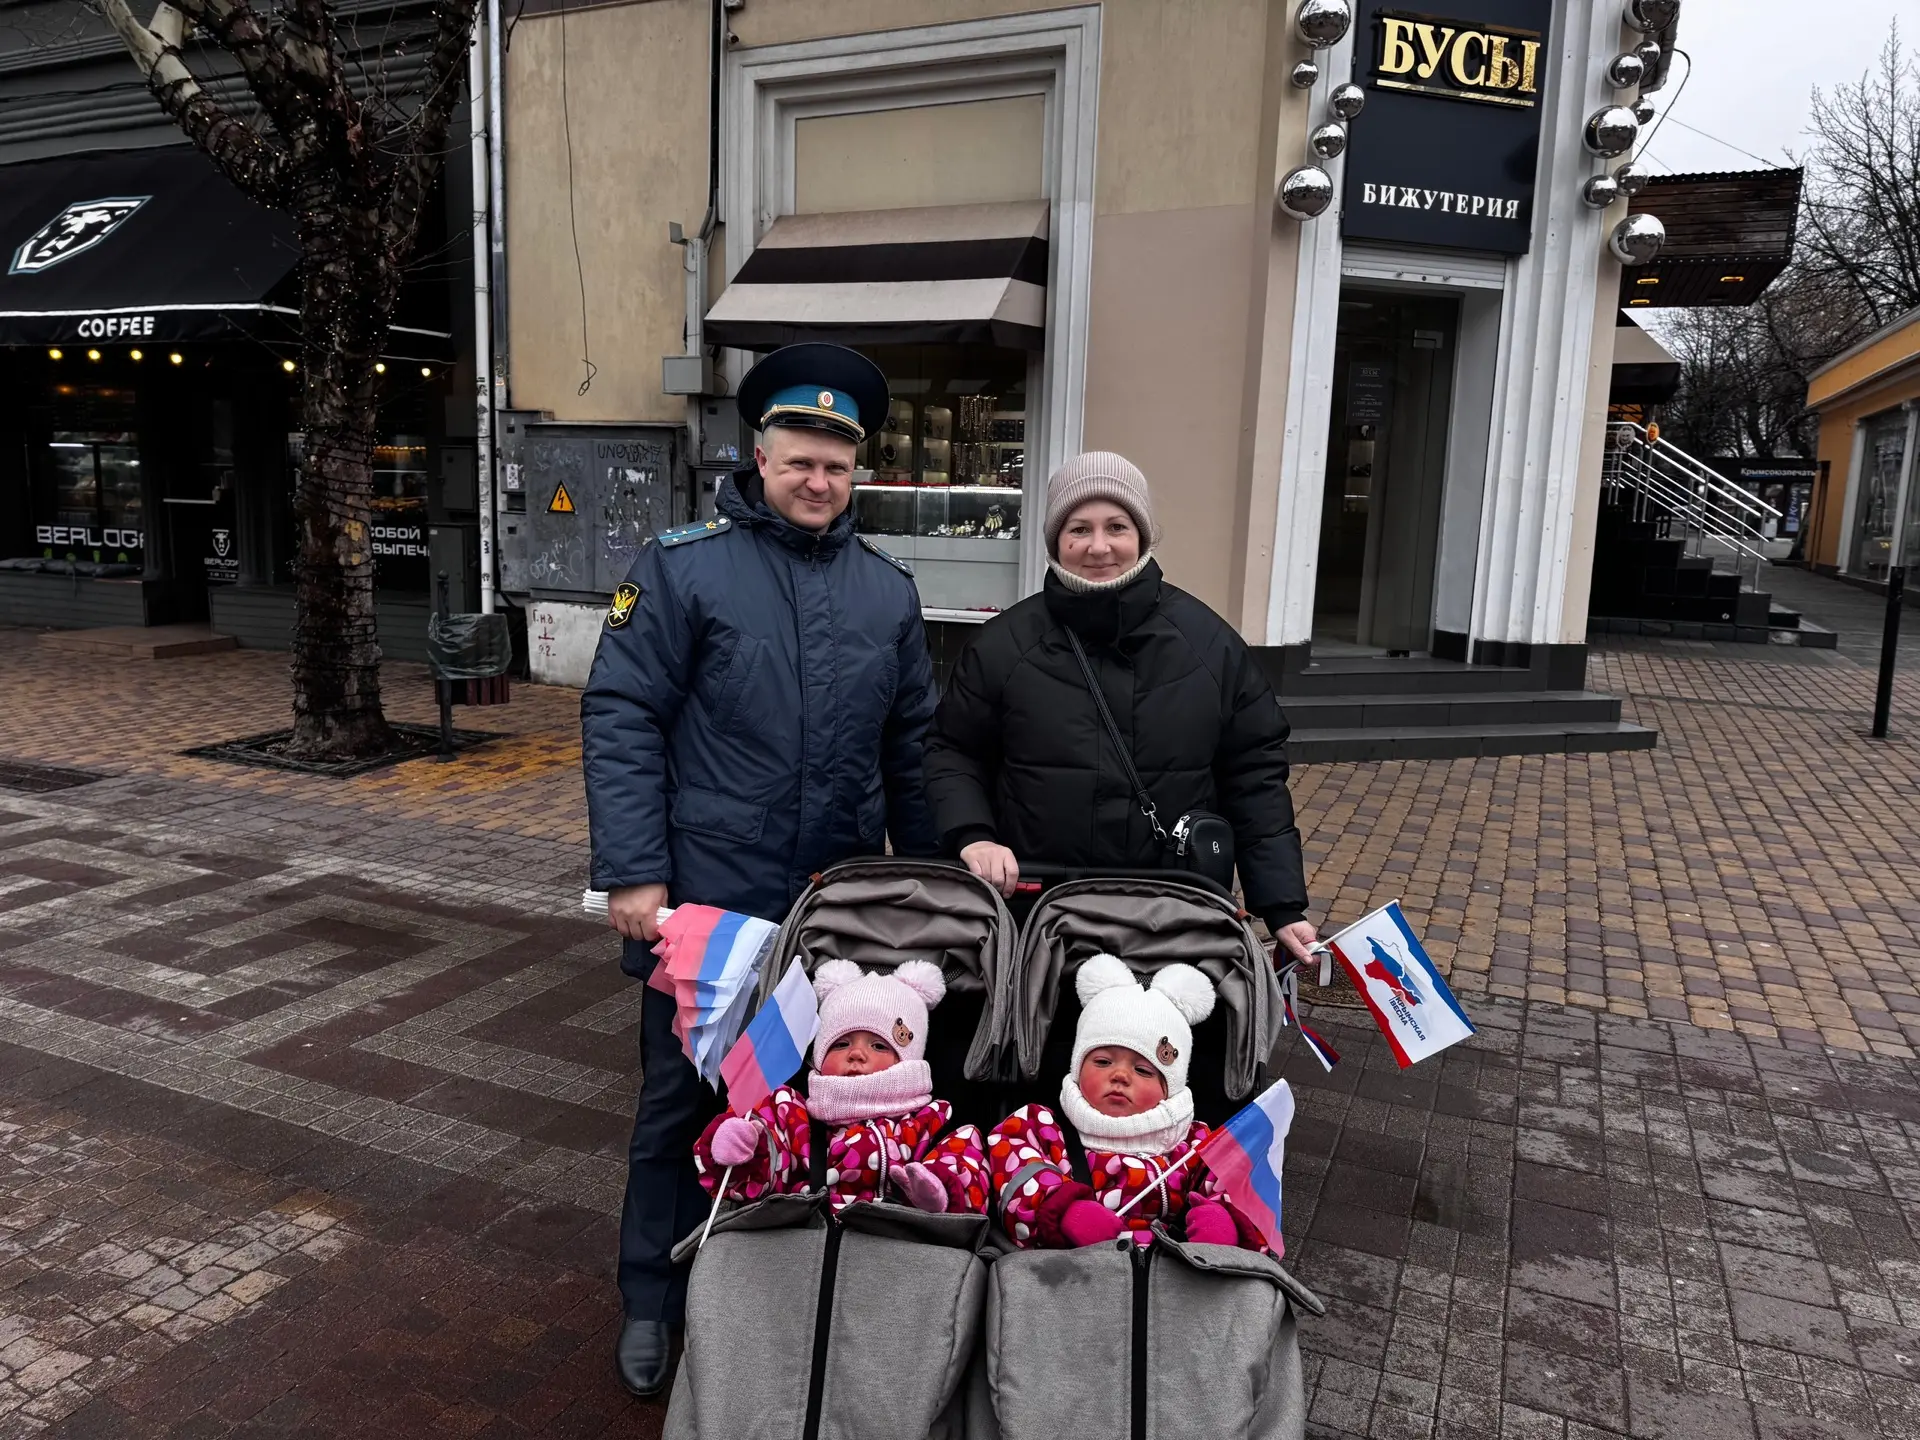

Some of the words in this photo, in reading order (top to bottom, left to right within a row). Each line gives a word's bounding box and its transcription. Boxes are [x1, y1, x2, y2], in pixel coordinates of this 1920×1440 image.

[1379, 17, 1541, 93] БУСЫ
[1362, 182, 1520, 219] БИЖУТЕРИЯ
[77, 316, 155, 338] COFFEE
[372, 543, 430, 557] ВЫПЕЧ
[1389, 1000, 1408, 1026] ВЕСНА
[1395, 994, 1426, 1041] КРЫМСКАЯ
